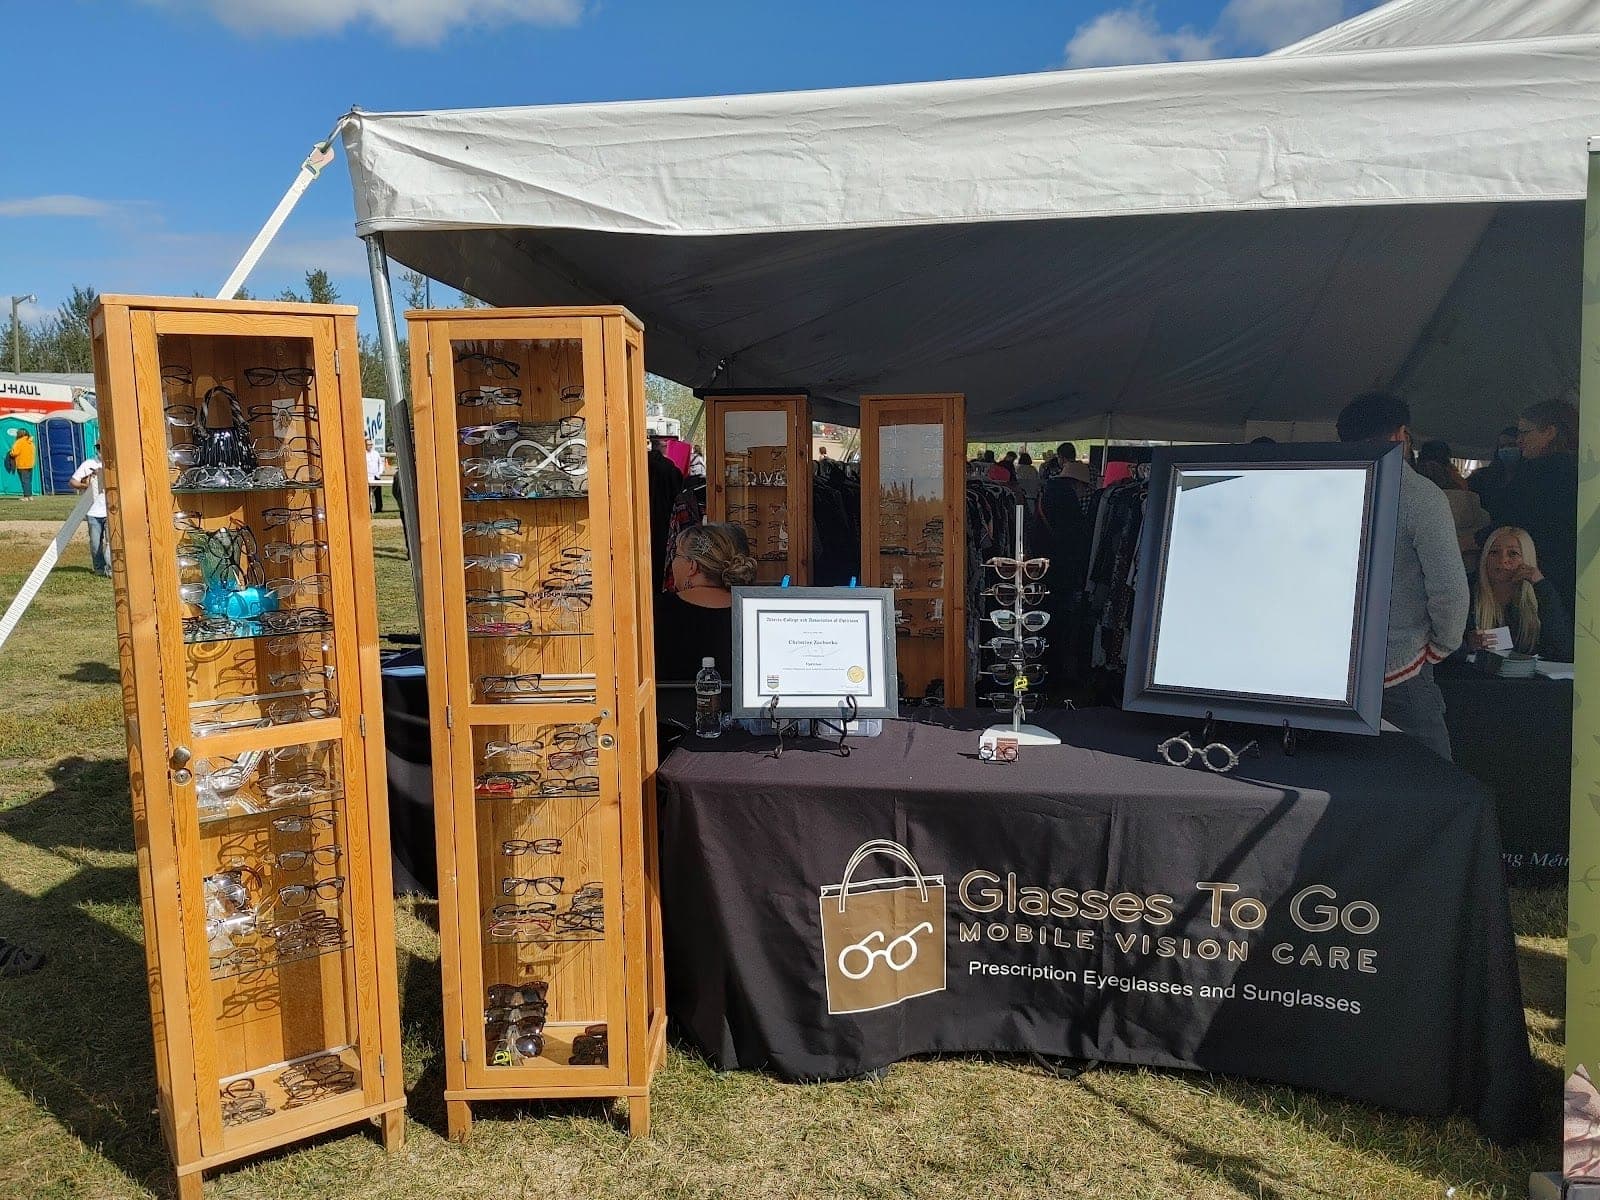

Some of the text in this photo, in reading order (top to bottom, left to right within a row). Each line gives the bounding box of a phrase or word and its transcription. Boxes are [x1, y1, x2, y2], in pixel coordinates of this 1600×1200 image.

[958, 869, 1380, 935] Glasses To Go
[959, 922, 1378, 973] MOBILE VISION CARE
[968, 960, 1362, 1015] Prescription Eyeglasses and Sunglasses
